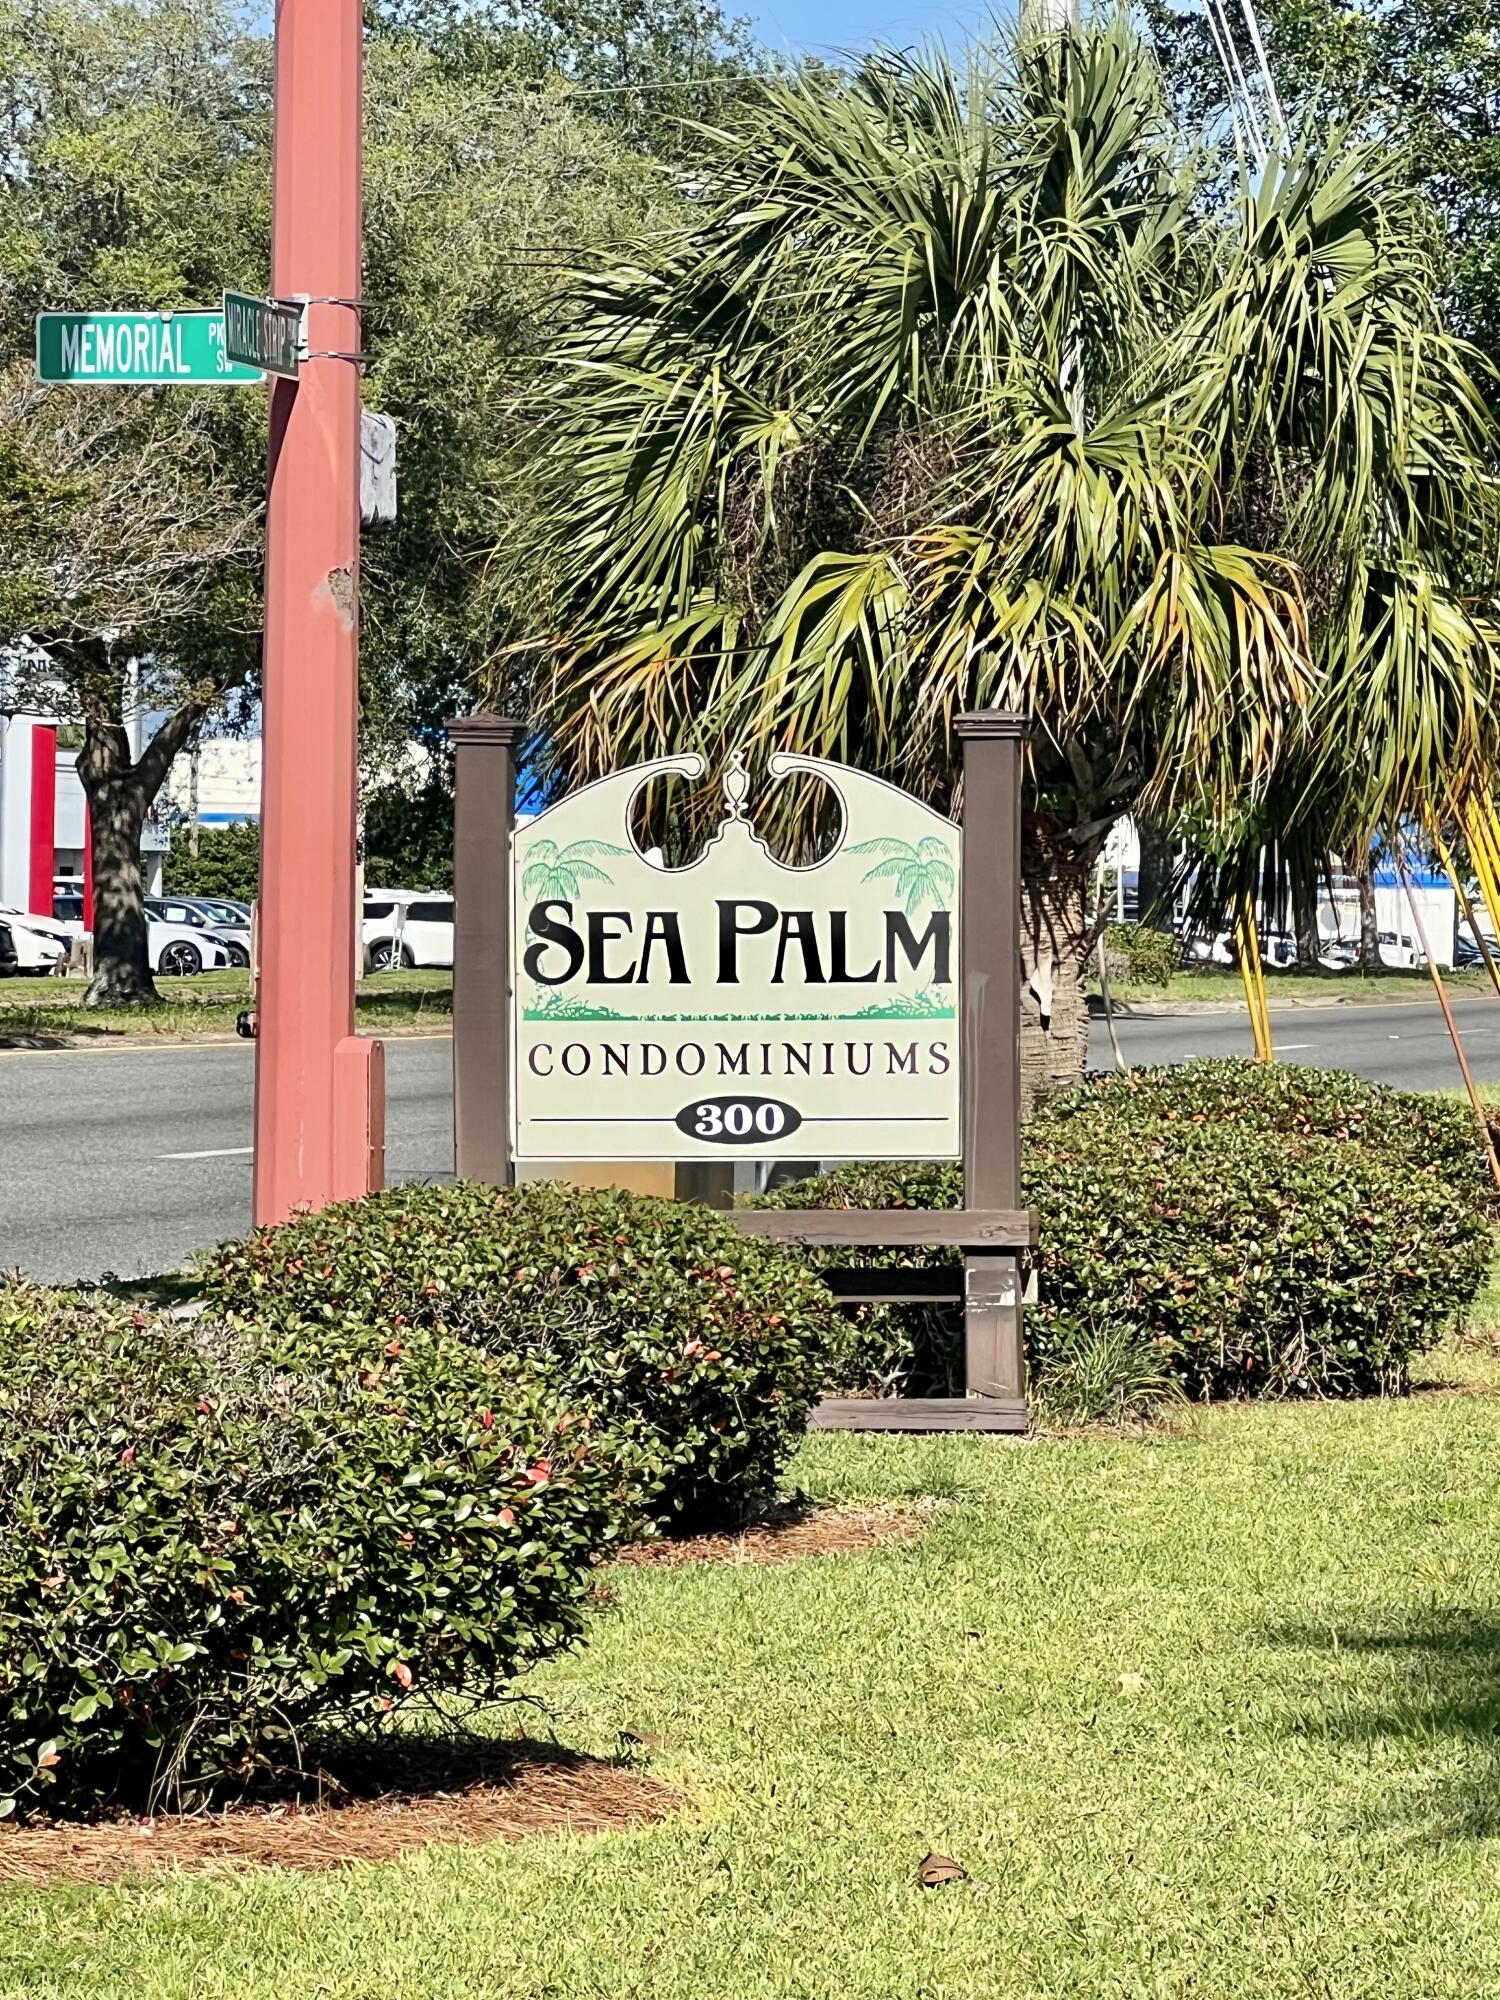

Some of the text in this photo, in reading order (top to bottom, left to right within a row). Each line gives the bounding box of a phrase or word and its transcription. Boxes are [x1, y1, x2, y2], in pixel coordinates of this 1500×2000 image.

[61, 323, 191, 374] MEMORIAL
[522, 899, 953, 986] SEA PALM
[527, 1042, 951, 1077] CONDOMINIUMS
[694, 1103, 786, 1136] 300
